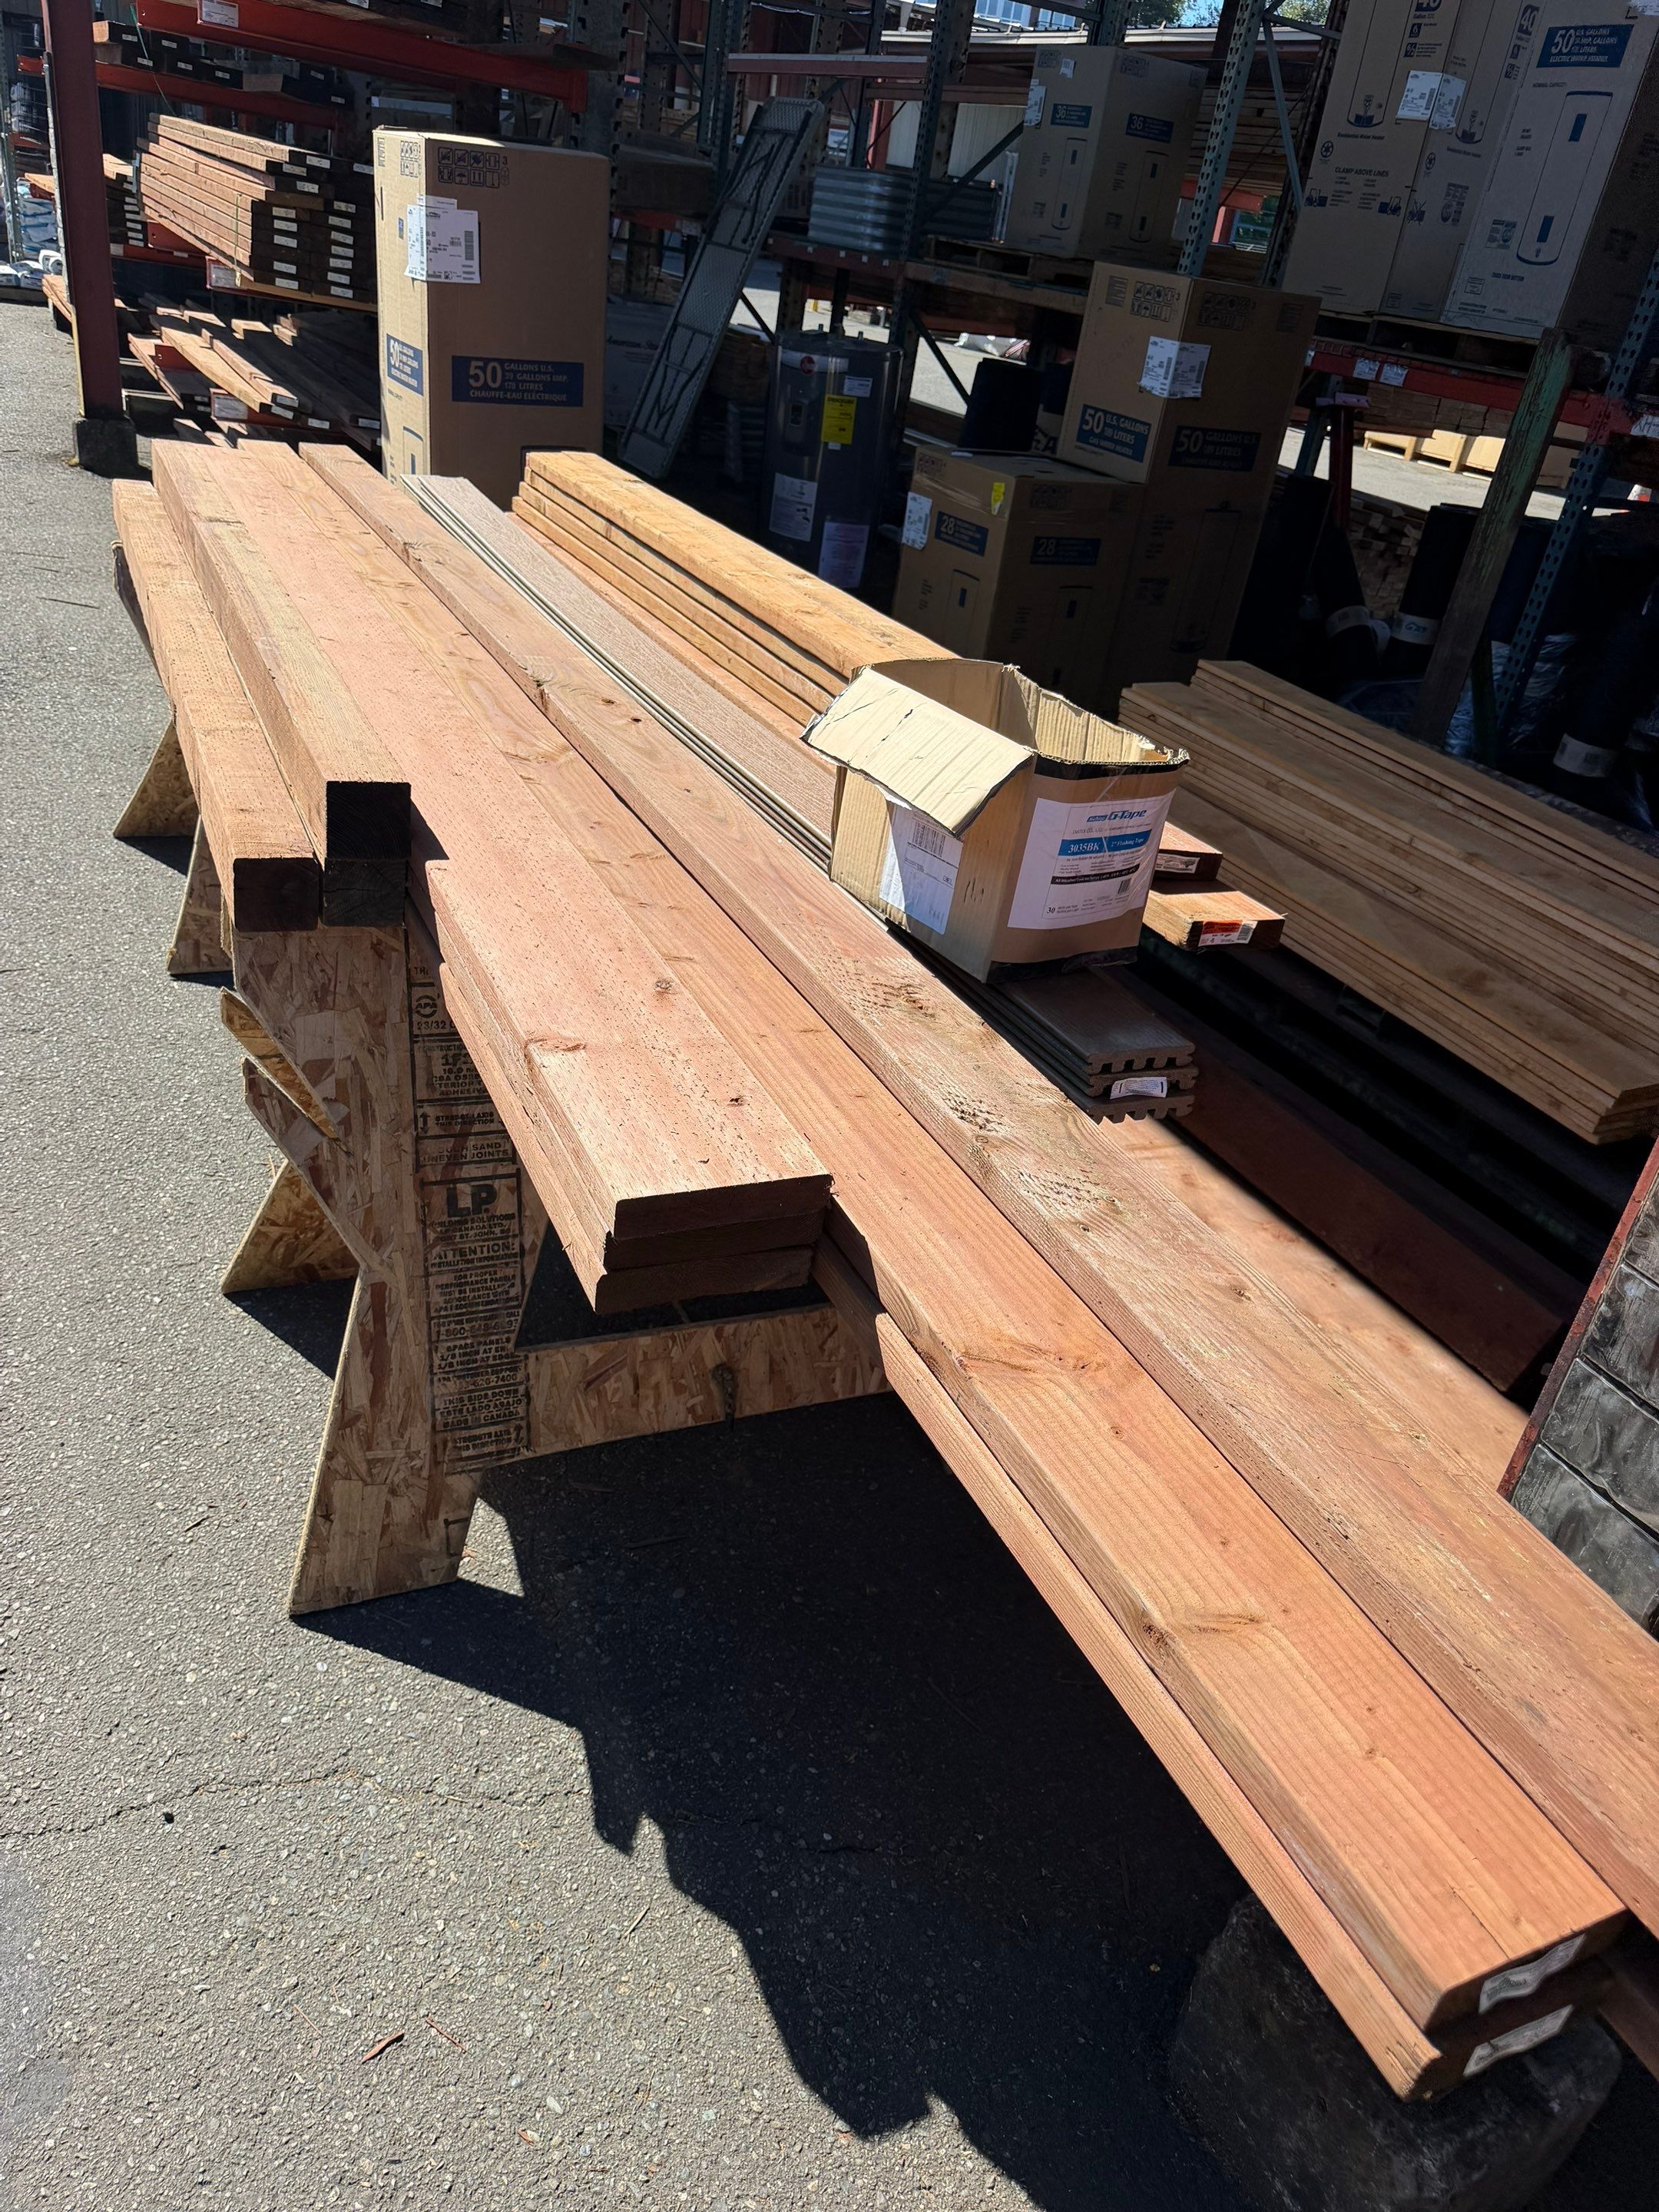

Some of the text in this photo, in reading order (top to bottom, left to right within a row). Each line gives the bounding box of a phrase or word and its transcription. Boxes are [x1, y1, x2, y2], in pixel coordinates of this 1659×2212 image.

[1551, 29, 1575, 54] 50
[1055, 104, 1066, 119] 36
[1131, 116, 1143, 131] 36
[502, 156, 507, 166] 3
[1354, 168, 1373, 177] ABOVE
[468, 361, 502, 389] 50
[504, 363, 538, 372] GALLONS
[516, 373, 551, 382] GALLONS
[518, 382, 544, 392] LITRES
[469, 390, 522, 400] CHAUFFE-EAU
[1081, 409, 1104, 435] 50
[1105, 413, 1149, 435] U.S. GALLONS
[1114, 430, 1135, 445] LITERS
[1175, 429, 1204, 455] 50
[1206, 432, 1242, 443] GALLONS
[940, 515, 955, 535] 28
[1037, 539, 1055, 556] 28
[1108, 810, 1147, 820] G-Tape
[1068, 842, 1100, 853] 3035BK
[472, 1142, 502, 1151] SAND
[470, 1149, 509, 1160] JOINTS
[446, 1184, 498, 1218] LP
[452, 1224, 488, 1233] CANADA
[488, 1222, 507, 1230] LTD.
[434, 1241, 515, 1260] ATTENTION:
[469, 1270, 498, 1280] PROPER
[446, 1336, 512, 1352] SPACE PANELS
[459, 1349, 480, 1359] INCH
[456, 1358, 478, 1367] INCH
[457, 1373, 518, 1390] -620-7400
[443, 1388, 519, 1406] THIS SIDE DOWN
[466, 1404, 492, 1413] LADO
[493, 1398, 522, 1410] ABAJO
[442, 1418, 469, 1429] MADE
[483, 1410, 520, 1422] CANADA
